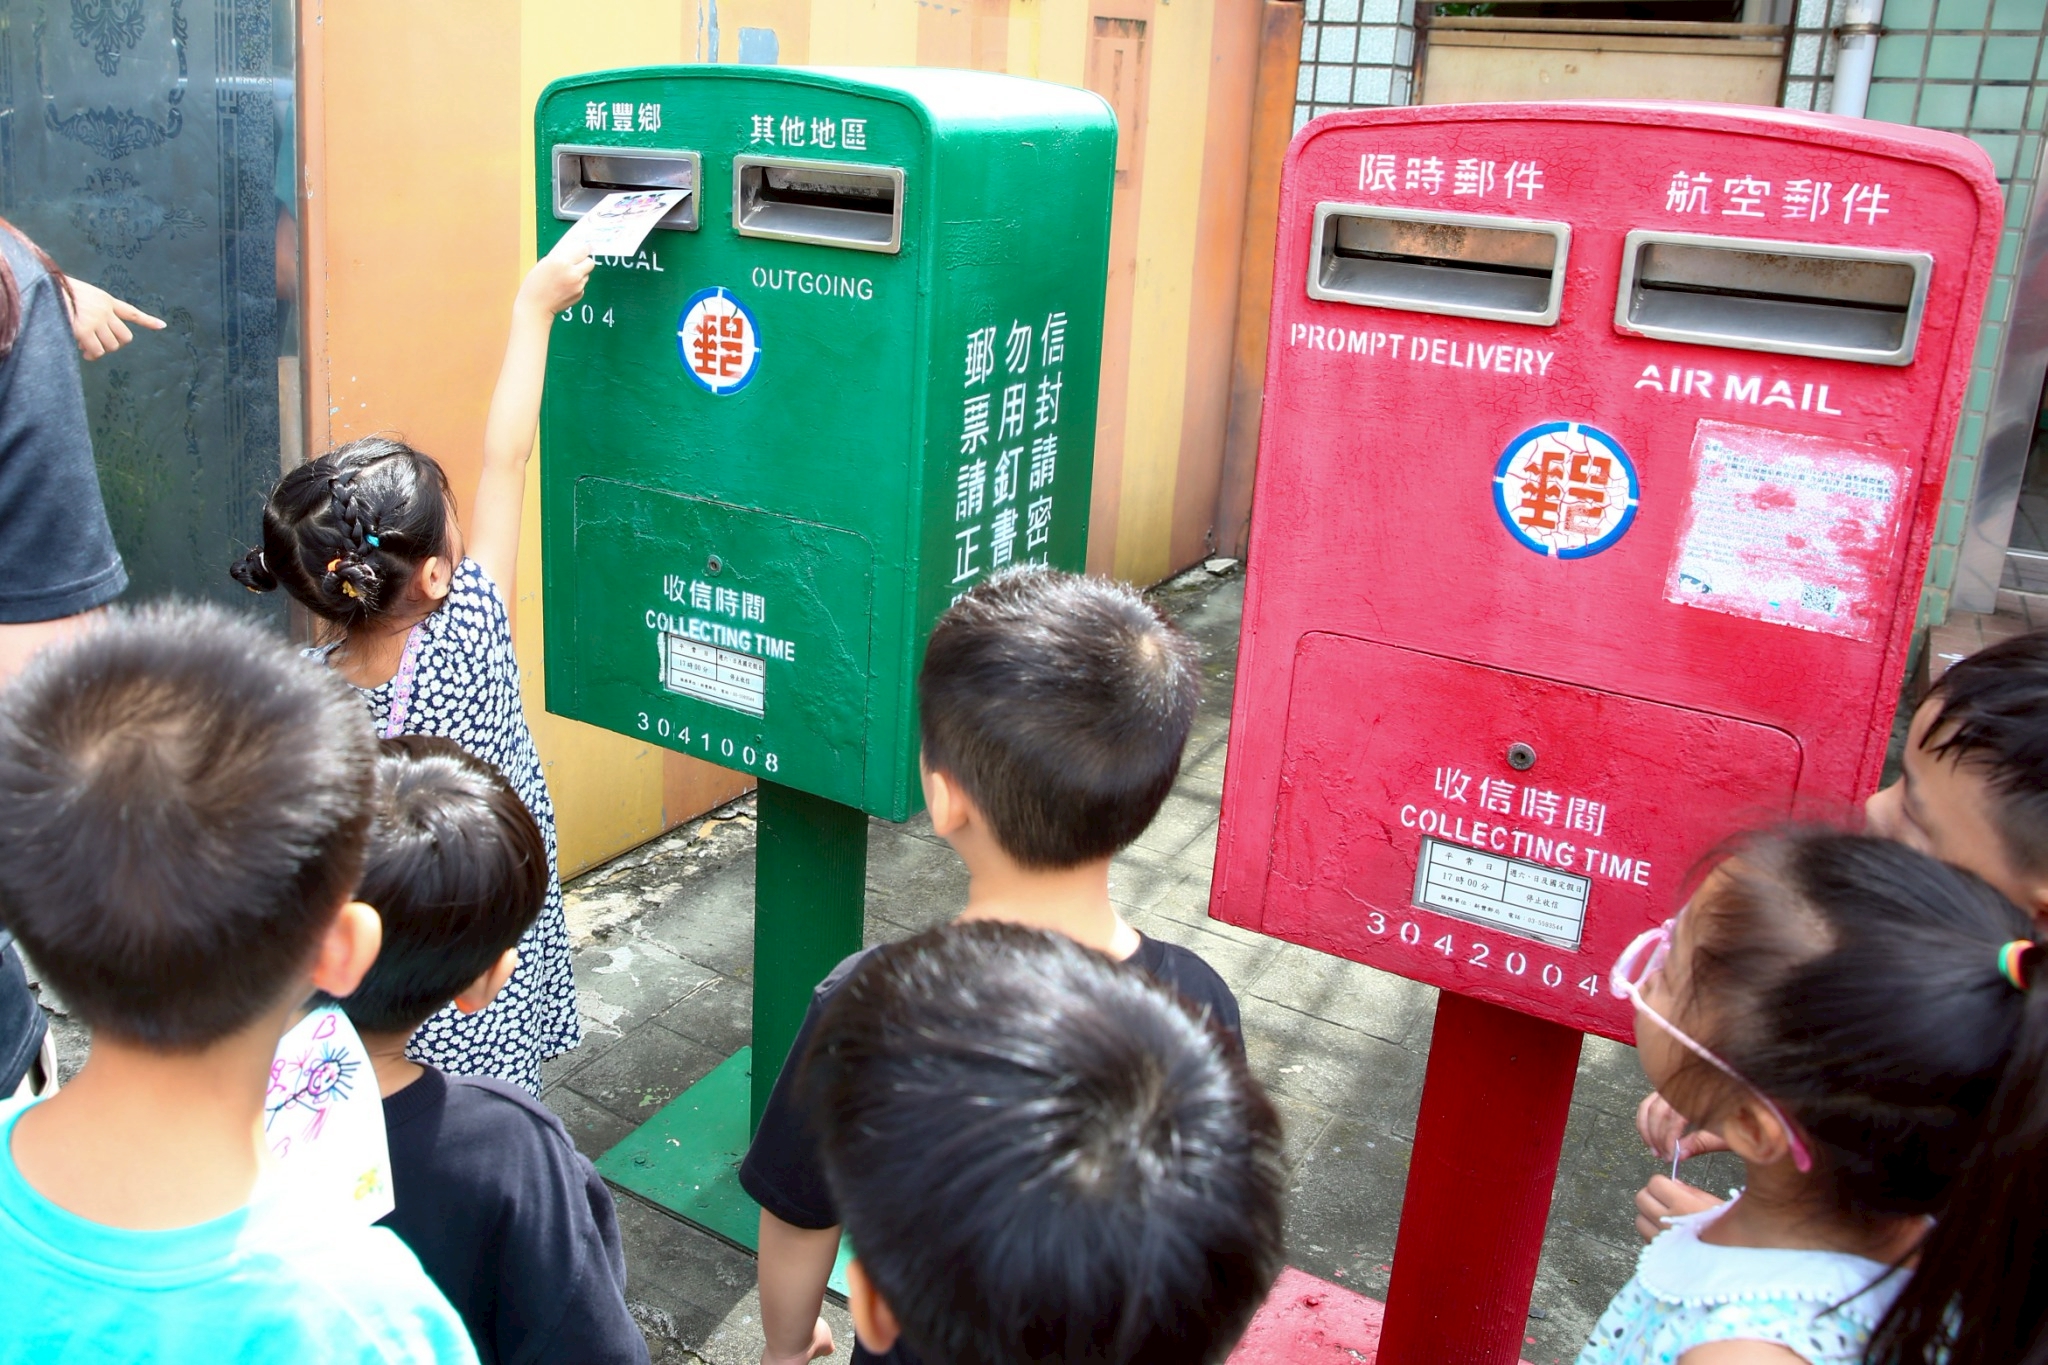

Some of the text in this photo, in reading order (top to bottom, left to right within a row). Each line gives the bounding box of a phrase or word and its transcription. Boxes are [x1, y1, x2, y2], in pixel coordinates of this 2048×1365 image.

[585, 101, 661, 133] 新豐鄉
[750, 114, 868, 150] 其他地區
[1358, 153, 1546, 201] 限時郵件
[1665, 170, 1891, 226] 航空郵件
[751, 266, 874, 300] OUTGOING
[1289, 322, 1556, 378] PROMPT DELIVERY
[1634, 363, 1843, 417] AIR MAIL
[951, 326, 997, 608] 郵票請正
[990, 319, 1032, 577] 勿用釘書
[663, 574, 765, 623] 收信時間
[645, 609, 795, 662] COLLECTING TIME
[637, 711, 779, 773] 3041008
[1434, 767, 1606, 837] 收信時間
[1400, 804, 1652, 886] COLLECTING TIME
[1526, 894, 1559, 910] 停止收信
[1366, 911, 1600, 997] 3042004
